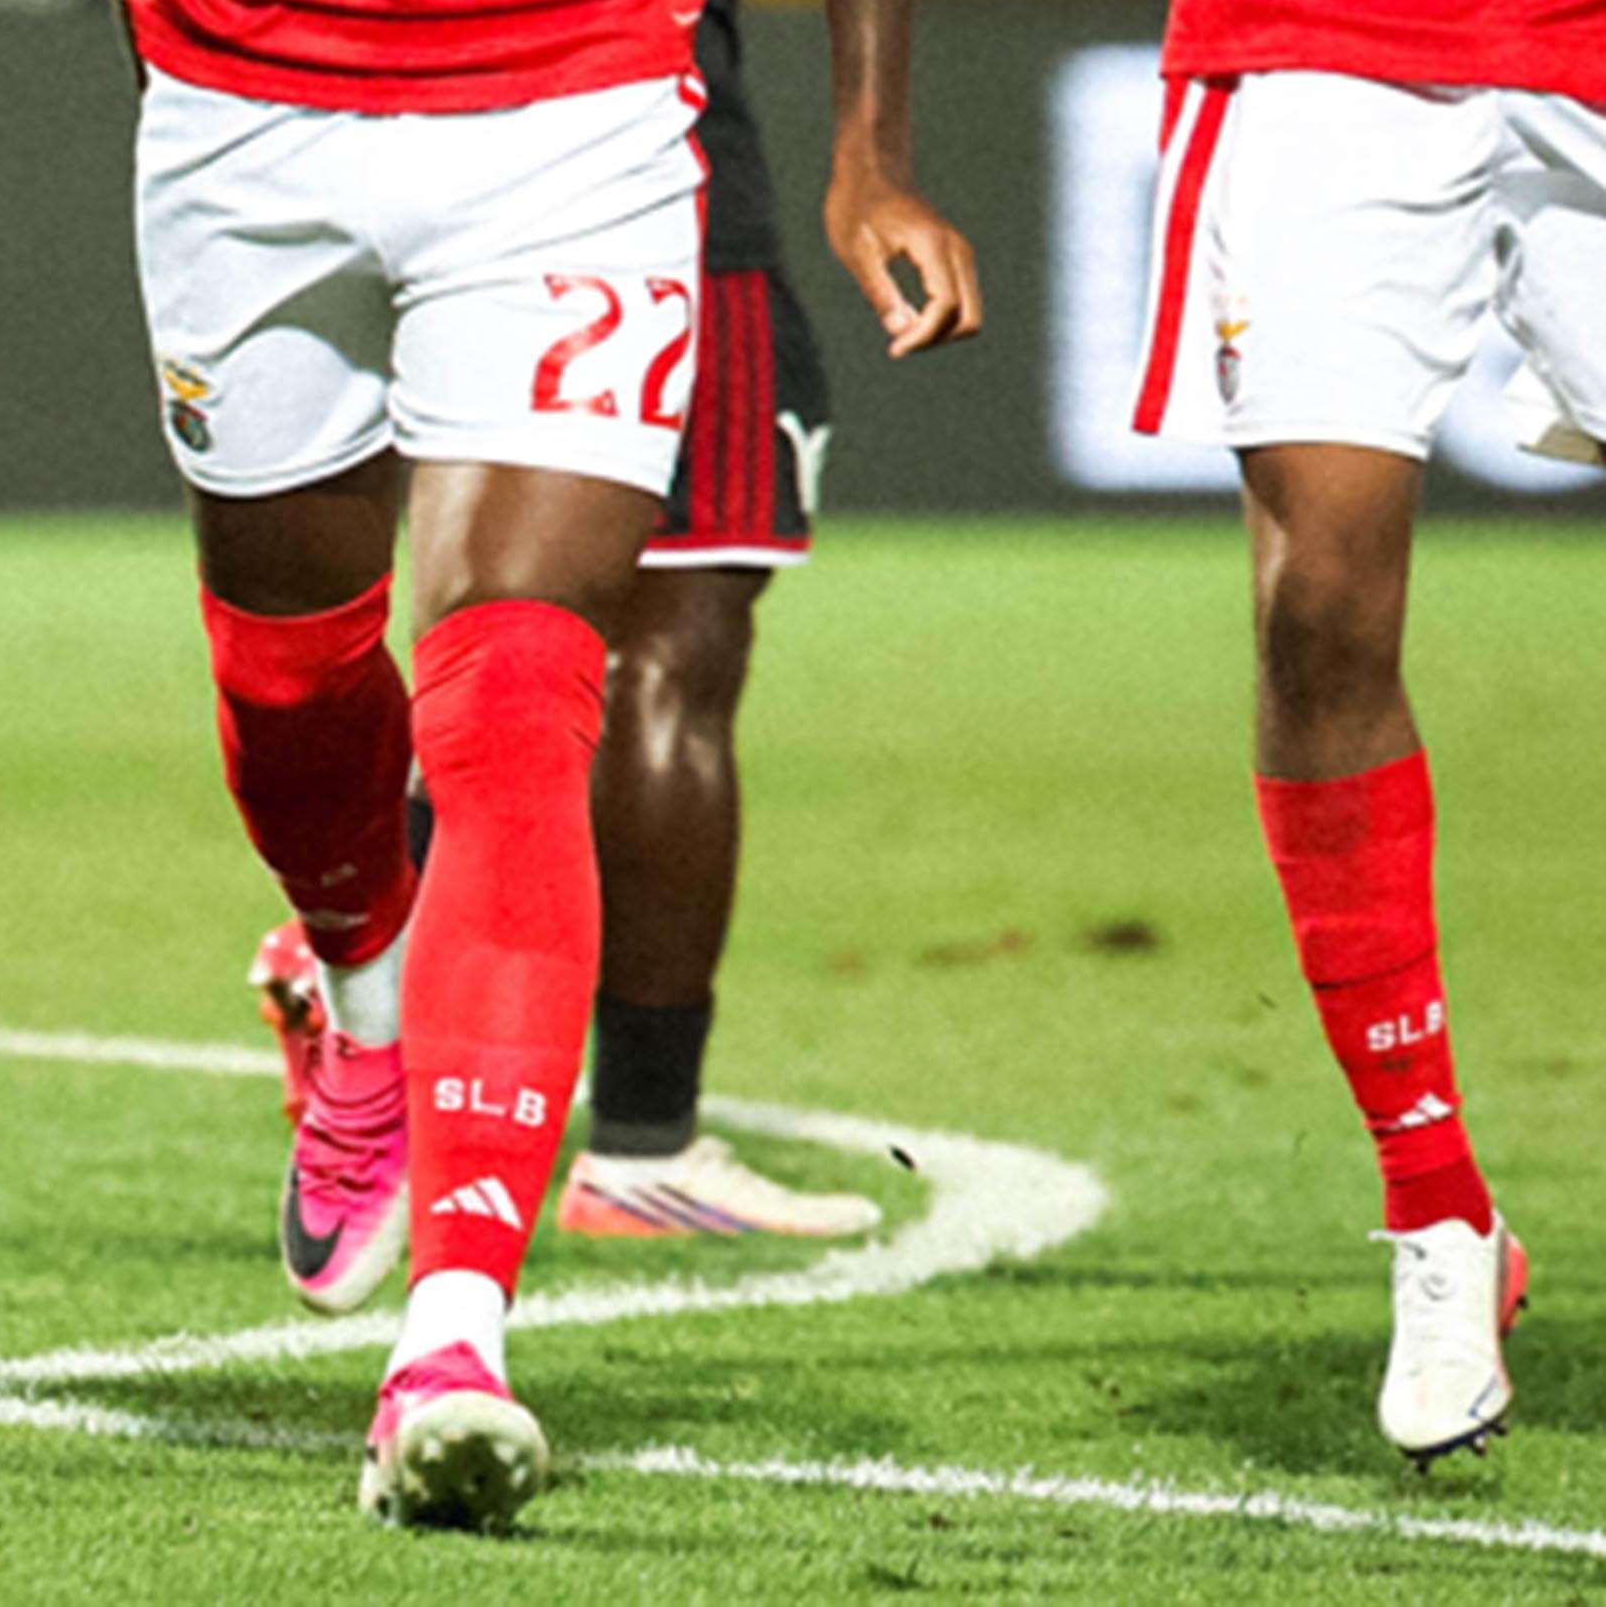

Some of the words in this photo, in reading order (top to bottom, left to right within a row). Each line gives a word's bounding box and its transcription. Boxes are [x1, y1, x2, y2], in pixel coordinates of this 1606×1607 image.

[530, 272, 693, 434] 22
[1366, 1000, 1444, 1052] SLB
[433, 1077, 547, 1127] SLB
